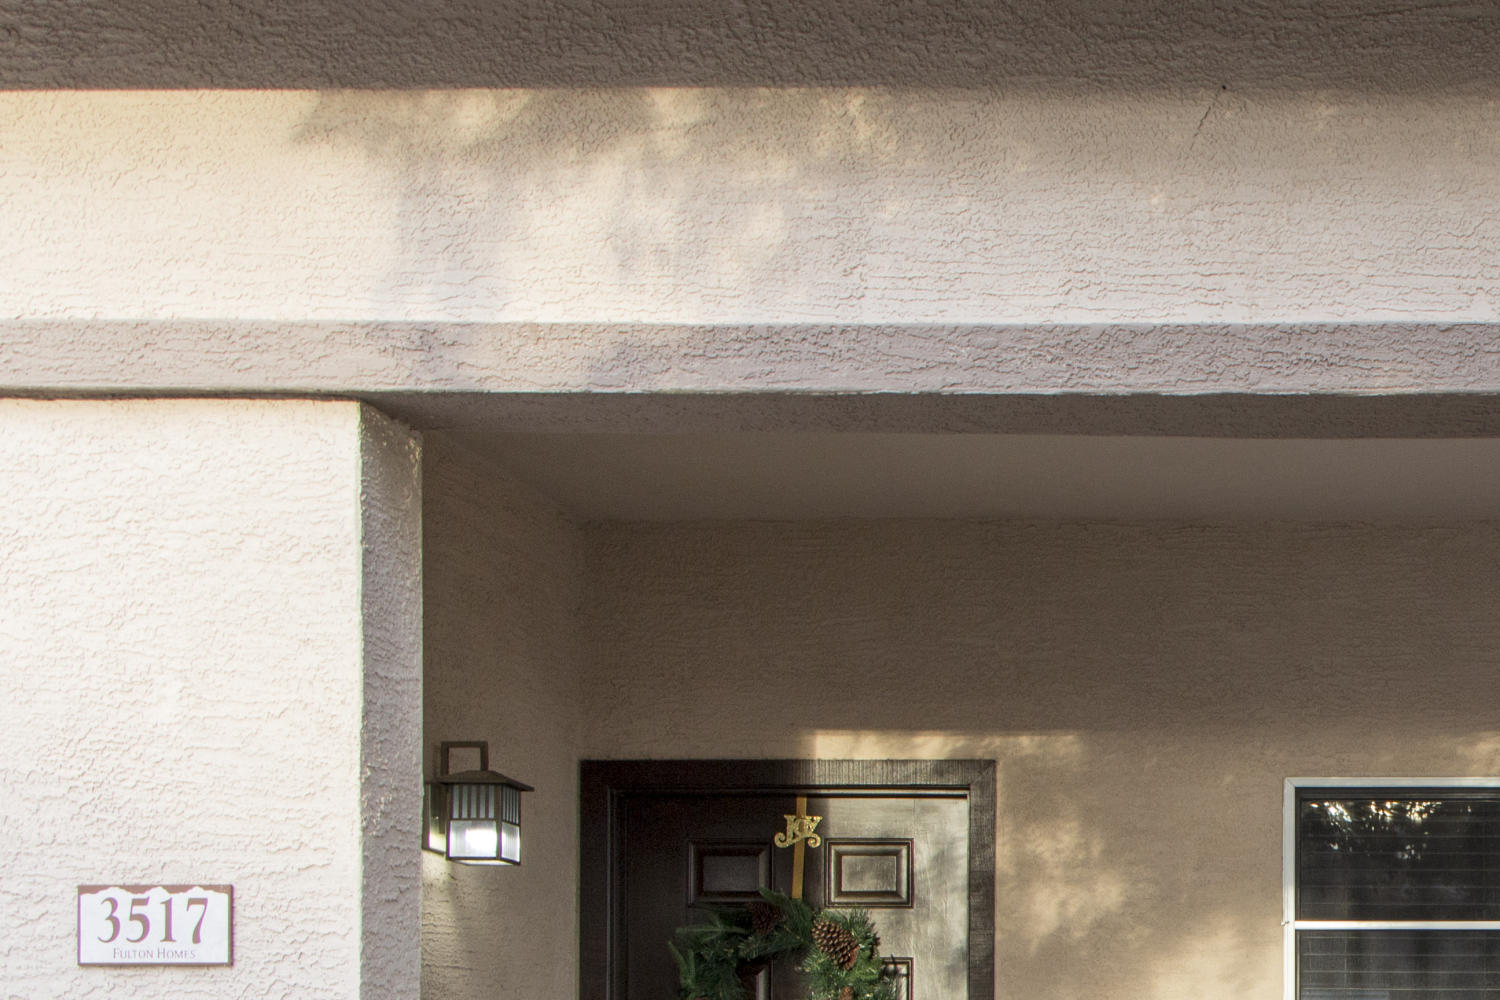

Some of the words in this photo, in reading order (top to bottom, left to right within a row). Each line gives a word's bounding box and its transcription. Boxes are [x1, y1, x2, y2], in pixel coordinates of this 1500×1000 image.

[775, 814, 823, 848] JOY
[97, 896, 208, 944] 3517
[113, 948, 153, 960] FULTON
[157, 948, 196, 960] HOMES
